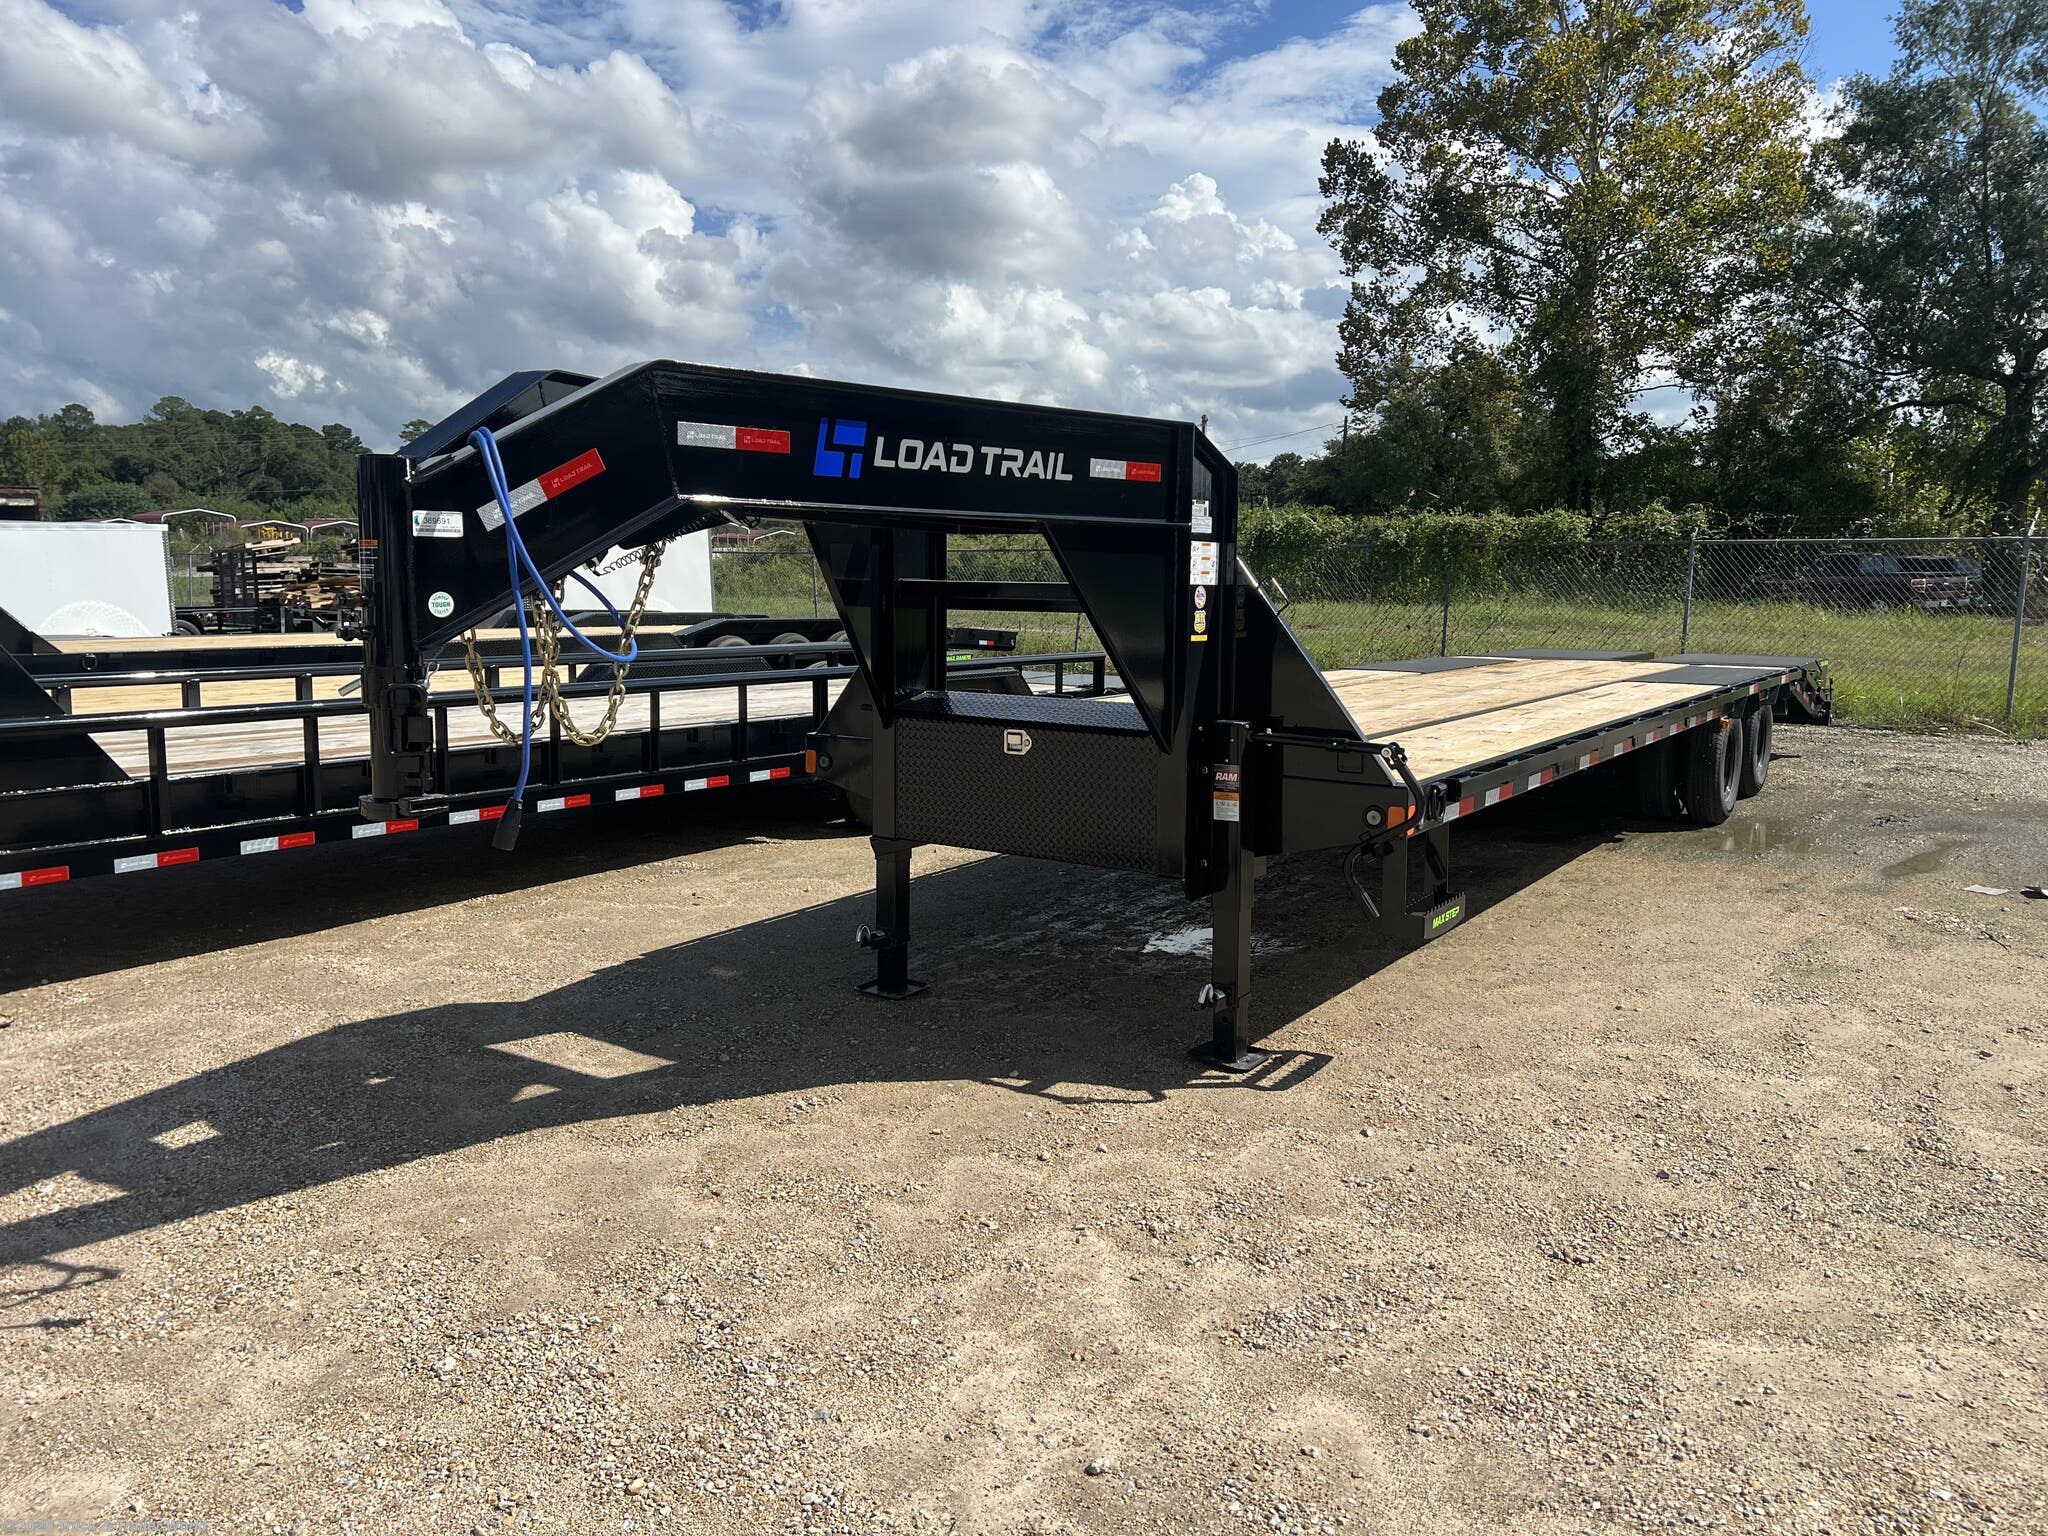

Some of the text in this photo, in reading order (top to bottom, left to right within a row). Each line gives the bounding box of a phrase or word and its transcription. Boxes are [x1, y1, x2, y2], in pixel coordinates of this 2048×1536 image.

[874, 436, 1073, 481] LOAD TRAIL
[1215, 771, 1238, 782] RAM
[1432, 905, 1460, 929] MAX STEP
